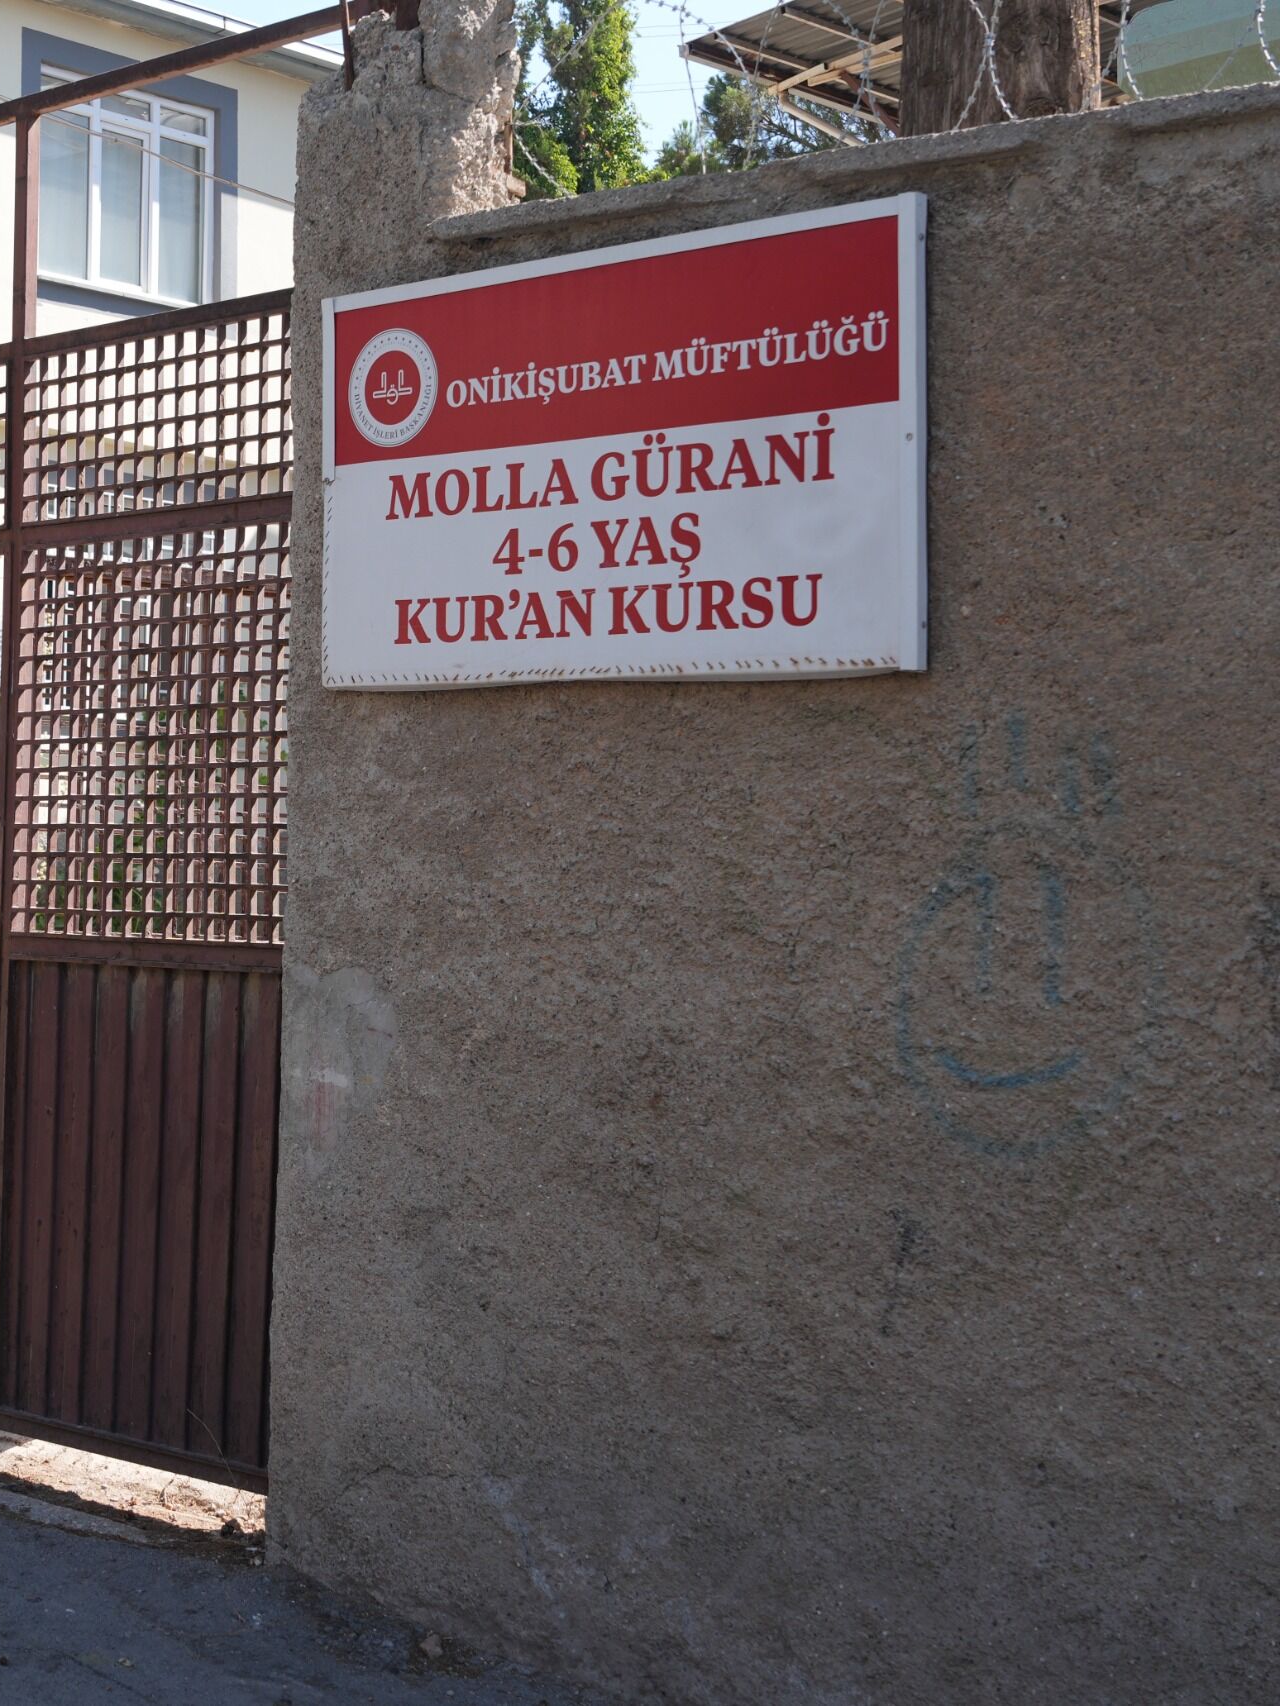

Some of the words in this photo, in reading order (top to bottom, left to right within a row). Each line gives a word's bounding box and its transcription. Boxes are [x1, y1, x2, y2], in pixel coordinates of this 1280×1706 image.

[447, 354, 645, 408] ONİKİŞUBAT
[652, 310, 890, 383] MÜFTÜLÜĞÜ
[385, 458, 579, 521] MOLLA
[590, 412, 836, 502] GÜRANİ
[492, 524, 579, 575] 4-6
[590, 512, 702, 578] YAŞ
[394, 587, 597, 645] KUR’AN
[608, 573, 824, 637] KURSU
